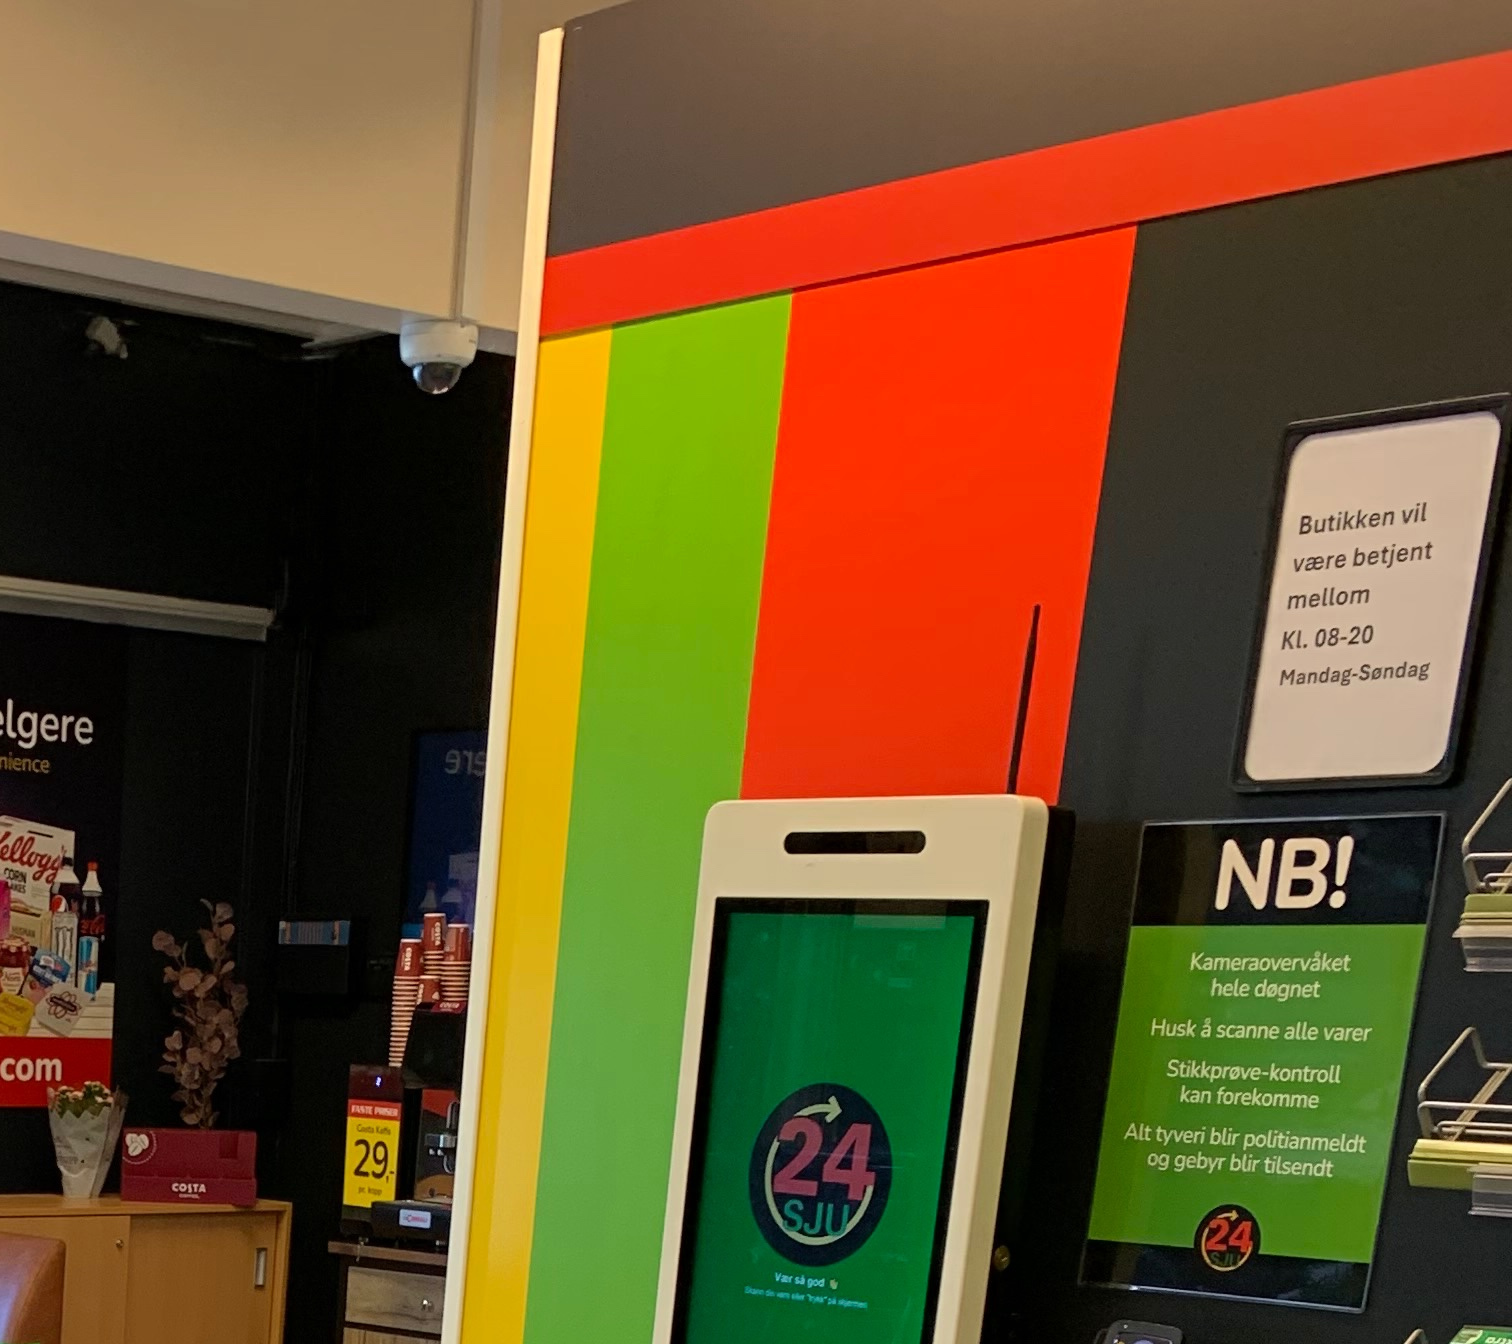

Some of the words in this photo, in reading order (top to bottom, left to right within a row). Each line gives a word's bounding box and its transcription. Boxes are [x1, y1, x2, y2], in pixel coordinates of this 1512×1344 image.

[1299, 508, 1395, 536] Butikken
[1402, 503, 1428, 525] vil
[1293, 552, 1347, 573] være
[1353, 541, 1434, 569] betjent
[1287, 586, 1371, 610] mellom
[1281, 629, 1309, 651] Kl.
[1314, 625, 1374, 648] 08-20
[1279, 660, 1432, 687] Mandag-Søndag
[1214, 836, 1355, 911] NB!
[1189, 950, 1351, 975] Kameraovervåket
[1210, 979, 1251, 998] hele
[1254, 980, 1322, 1002] døgnet
[1150, 1018, 1197, 1039] Husk
[1200, 1018, 1213, 1039] å
[1216, 1022, 1281, 1040] scanne
[1283, 1022, 1320, 1041] alle
[1322, 1025, 1373, 1043] varer
[1166, 1059, 1342, 1085] Stikkprøve-kontroll
[1179, 1084, 1213, 1105] kan
[1216, 1086, 1320, 1109] forekomme
[1123, 1123, 1153, 1141] Alt
[1155, 1125, 1206, 1147] tyveri
[1209, 1127, 1241, 1147] blir
[1243, 1130, 1368, 1156] politianmeldt
[773, 1116, 877, 1201] 24
[1147, 1153, 1171, 1173] og
[1174, 1152, 1226, 1175] gebyr
[1229, 1152, 1261, 1173] blir
[1264, 1155, 1335, 1179] tilsendt
[171, 1183, 207, 1194] COSTA
[782, 1199, 851, 1237] SJU
[1206, 1217, 1254, 1254] 24
[774, 1271, 793, 1283] Vær
[794, 1274, 806, 1285] så
[806, 1278, 826, 1288] god
